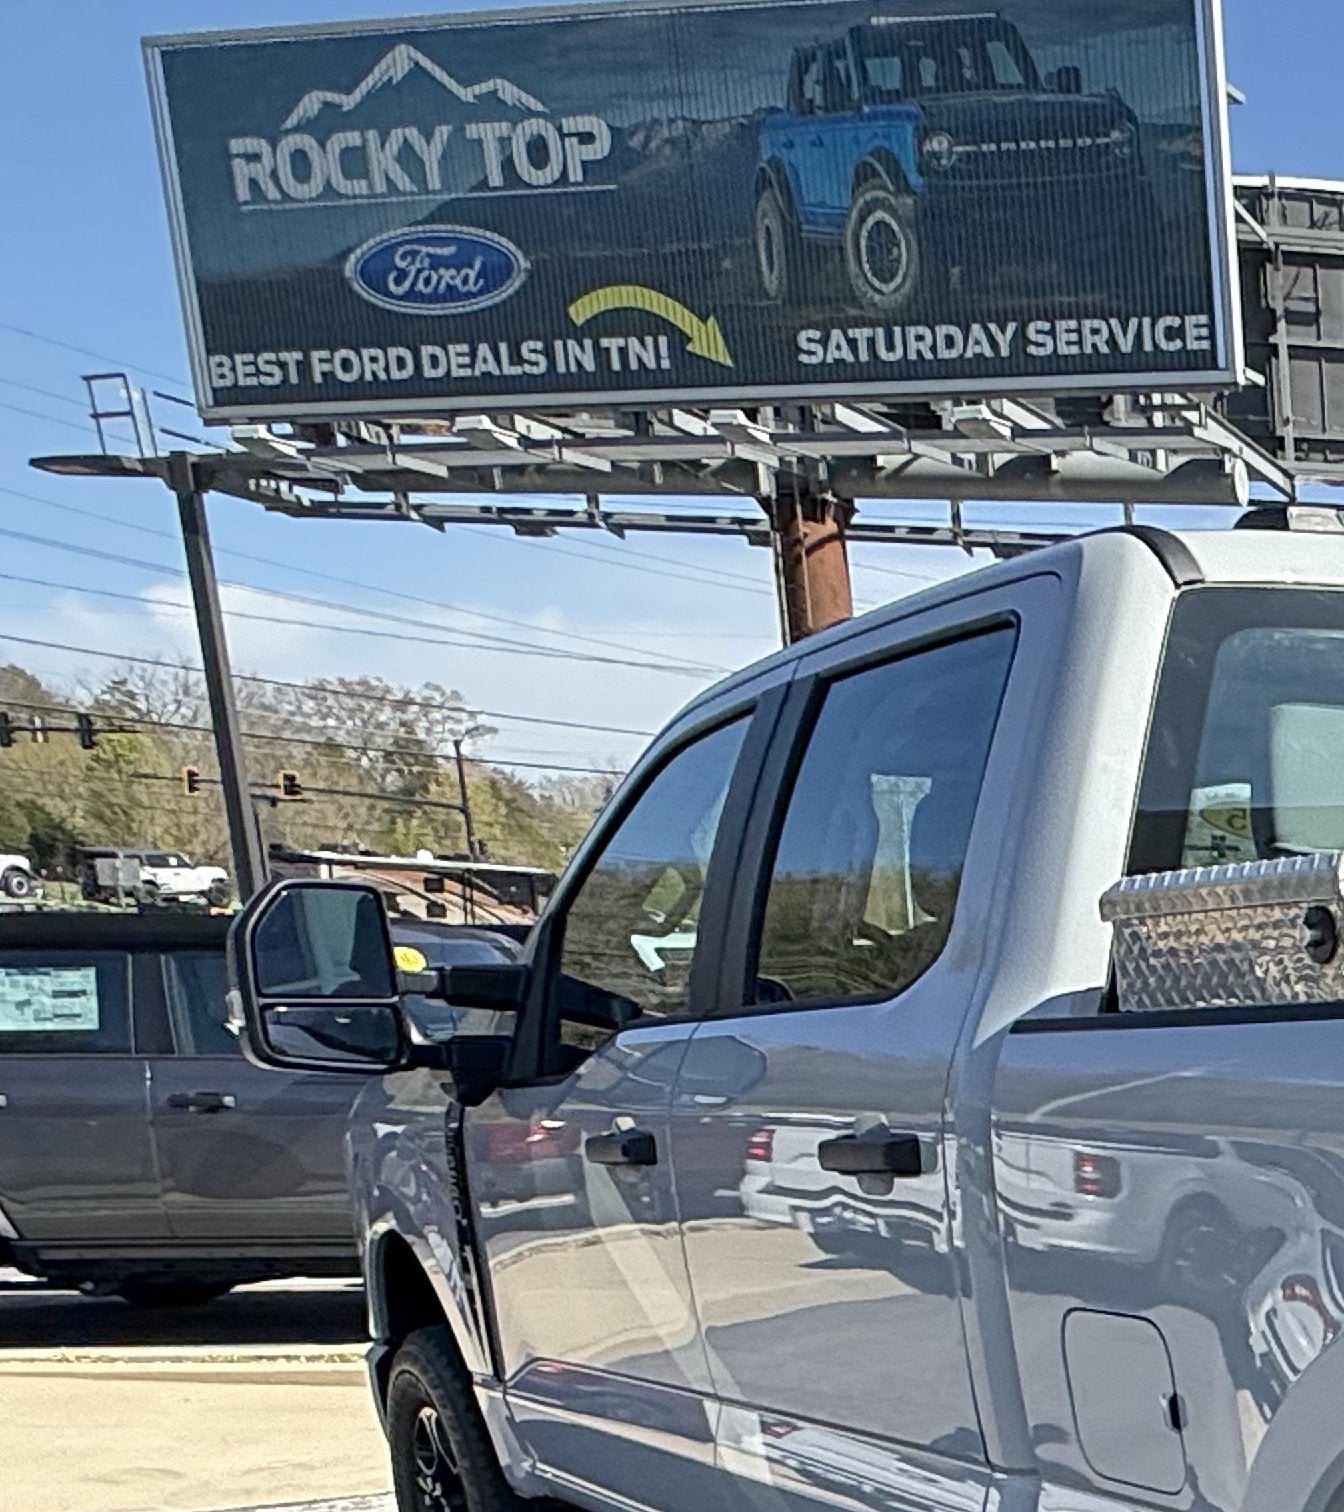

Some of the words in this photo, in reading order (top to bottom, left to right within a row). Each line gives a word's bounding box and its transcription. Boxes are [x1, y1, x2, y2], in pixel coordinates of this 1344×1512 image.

[228, 125, 452, 202] ROCKY
[465, 115, 612, 188] TOP
[387, 244, 486, 294] Ford
[209, 350, 304, 388] BEST
[309, 346, 415, 383] FORD
[421, 341, 547, 379] DEALS
[554, 338, 594, 373] IN
[797, 322, 1018, 365] SATURDAY
[1026, 314, 1211, 356] SERVICE
